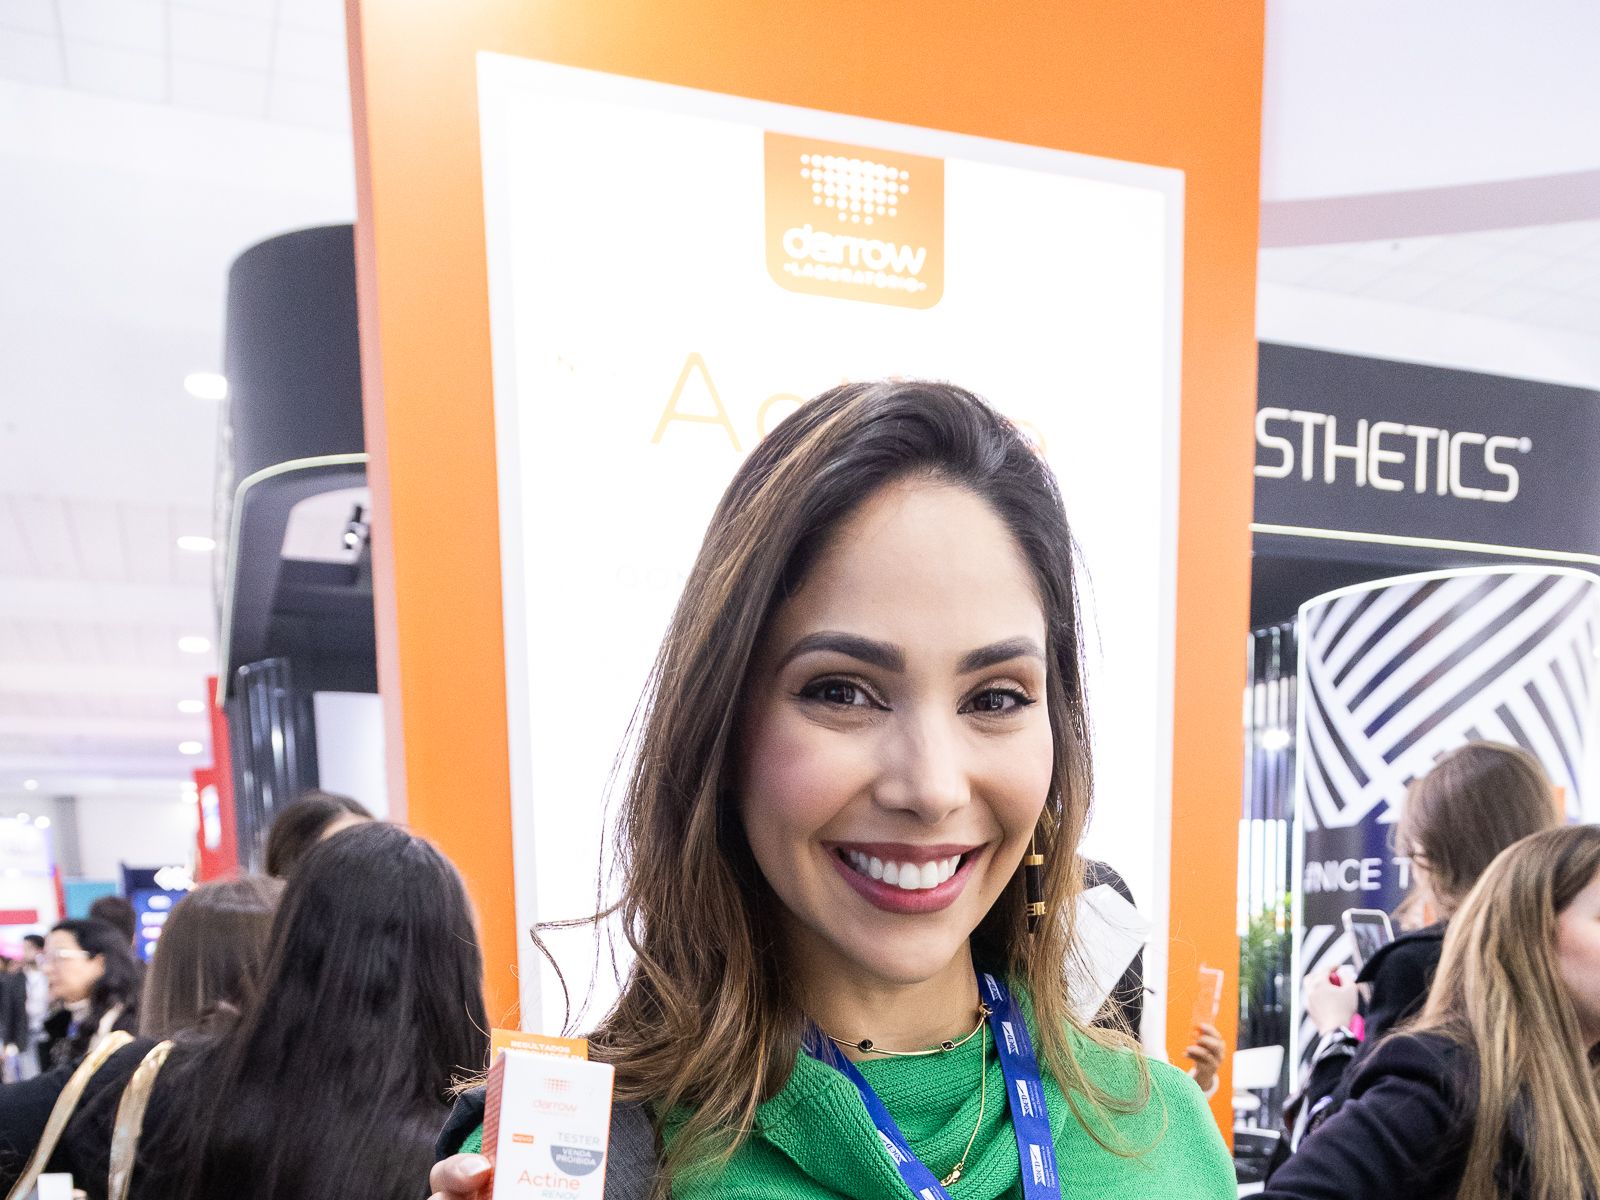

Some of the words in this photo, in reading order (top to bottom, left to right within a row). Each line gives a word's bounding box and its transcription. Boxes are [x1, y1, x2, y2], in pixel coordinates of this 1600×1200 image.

[558, 1132, 600, 1146] TESTER
[563, 1148, 592, 1158] VENDA
[555, 1154, 596, 1166] PROIBIDA
[517, 1168, 581, 1191] Actine
[542, 1189, 579, 1200] RENOV
